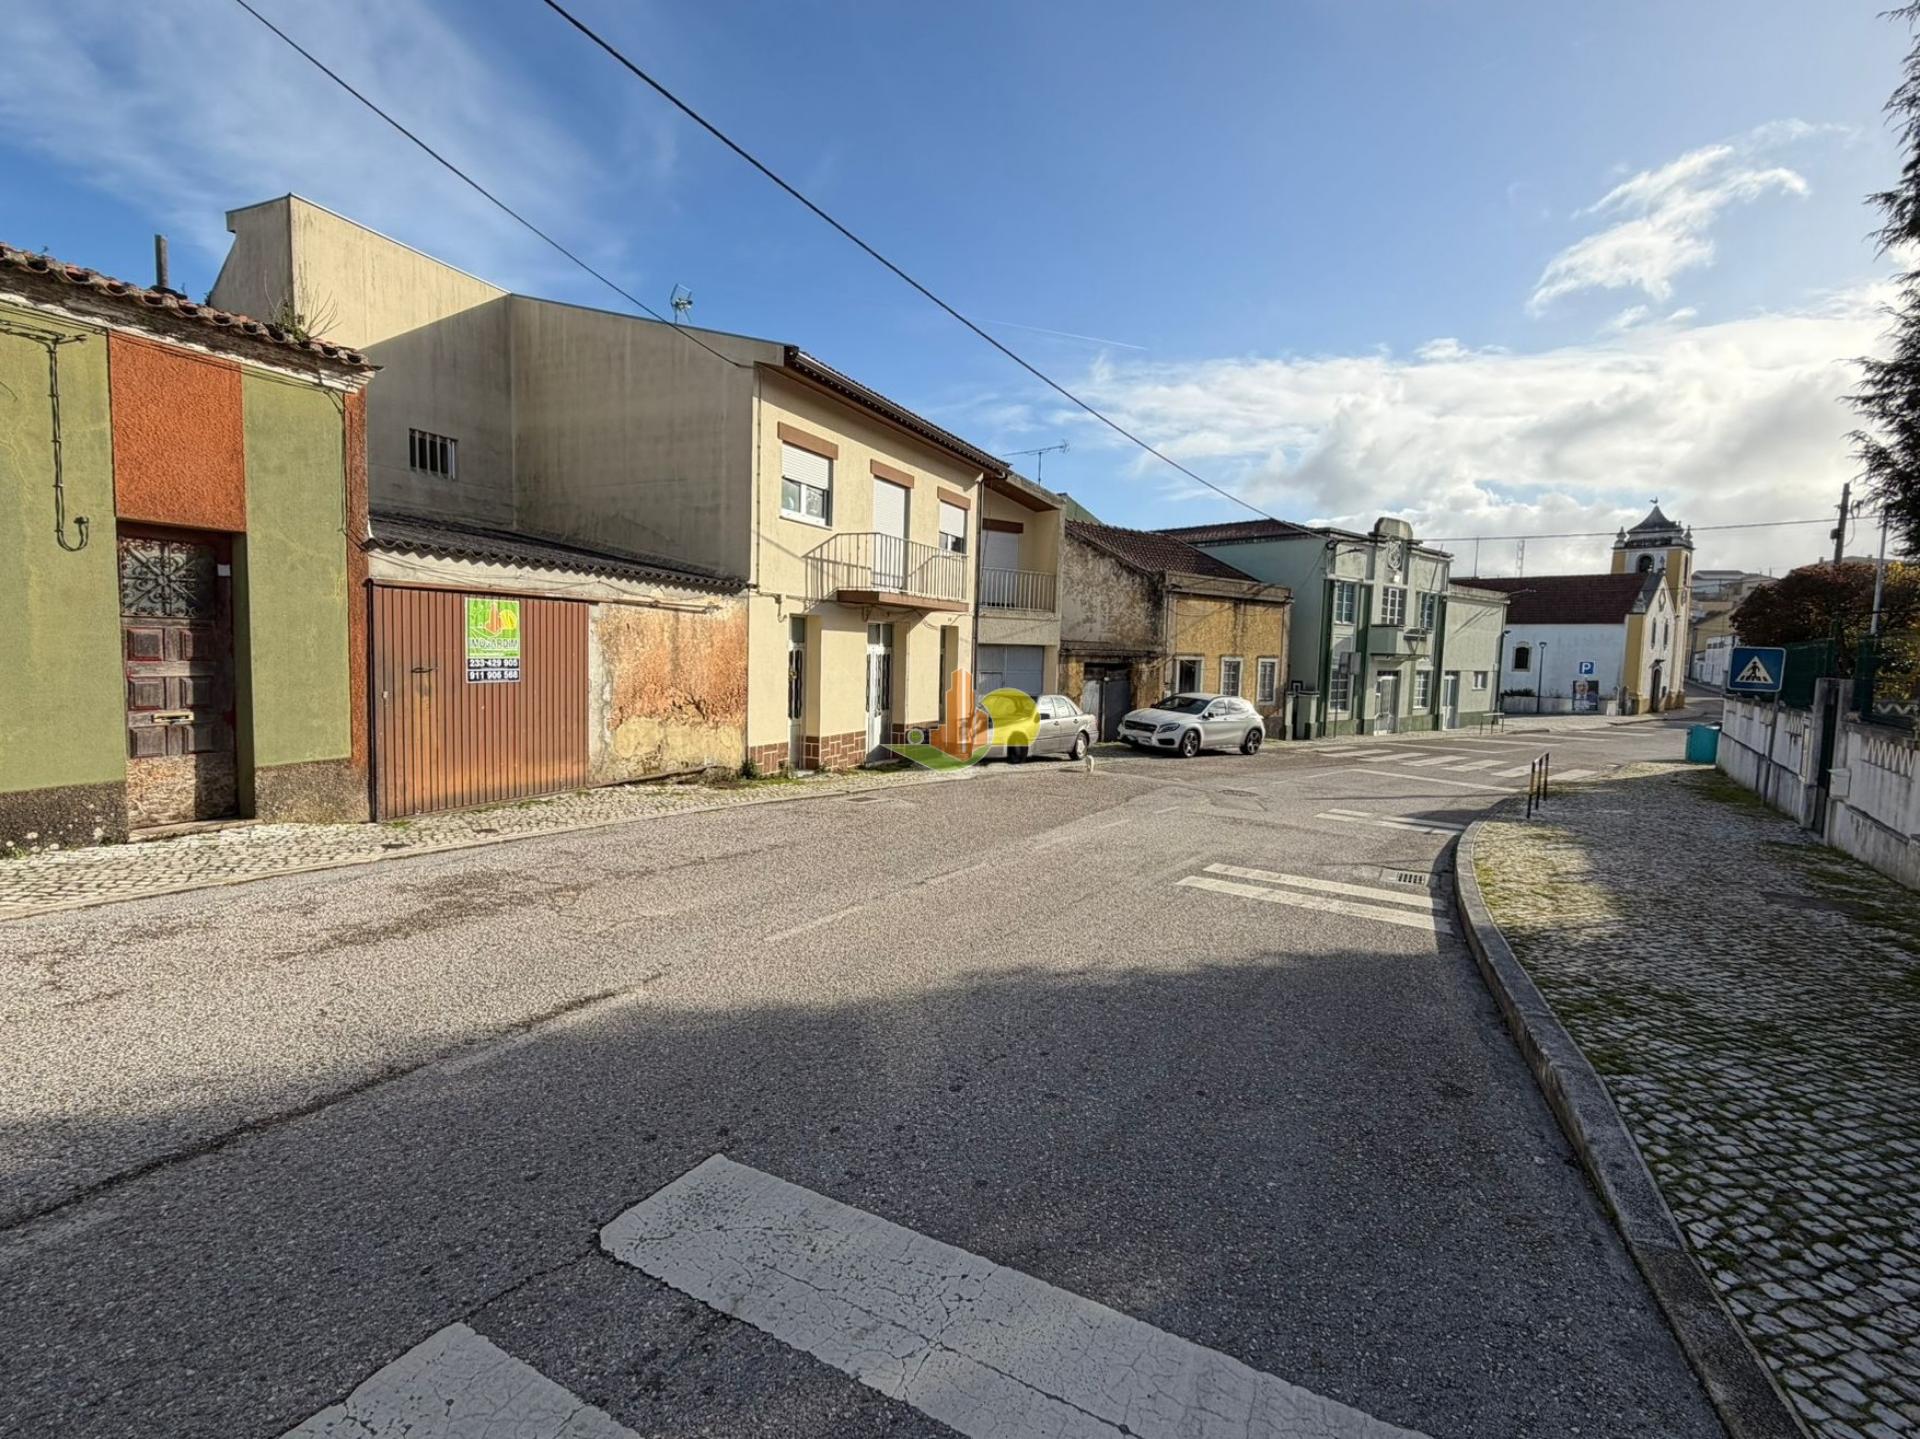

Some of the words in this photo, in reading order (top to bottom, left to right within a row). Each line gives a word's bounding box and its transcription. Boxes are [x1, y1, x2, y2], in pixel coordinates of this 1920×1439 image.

[469, 658, 485, 667] 233
[1582, 662, 1592, 673] P
[469, 670, 485, 680] 911
